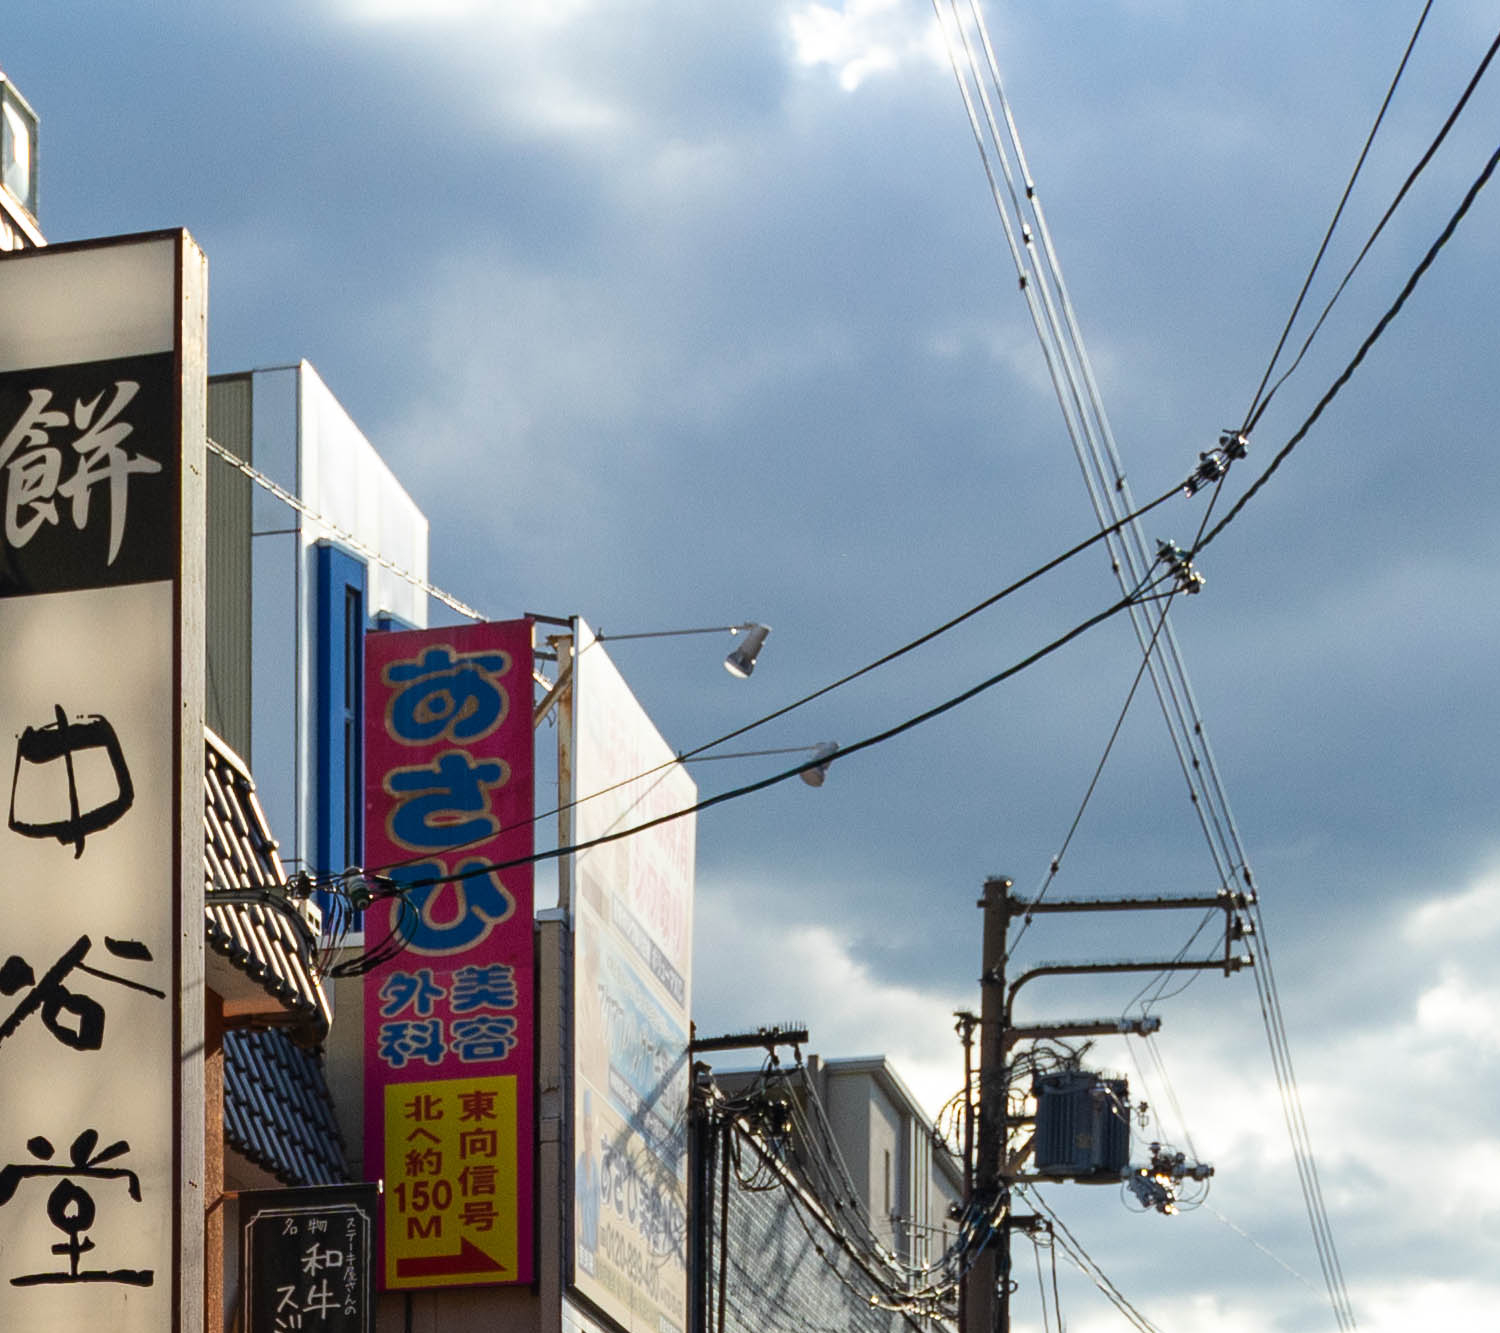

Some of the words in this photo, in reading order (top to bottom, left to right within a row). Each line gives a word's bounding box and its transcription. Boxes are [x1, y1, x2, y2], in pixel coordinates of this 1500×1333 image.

[384, 643, 518, 956] あさひ
[457, 1089, 499, 1233] 東向信号
[301, 1242, 344, 1320] 和牛
